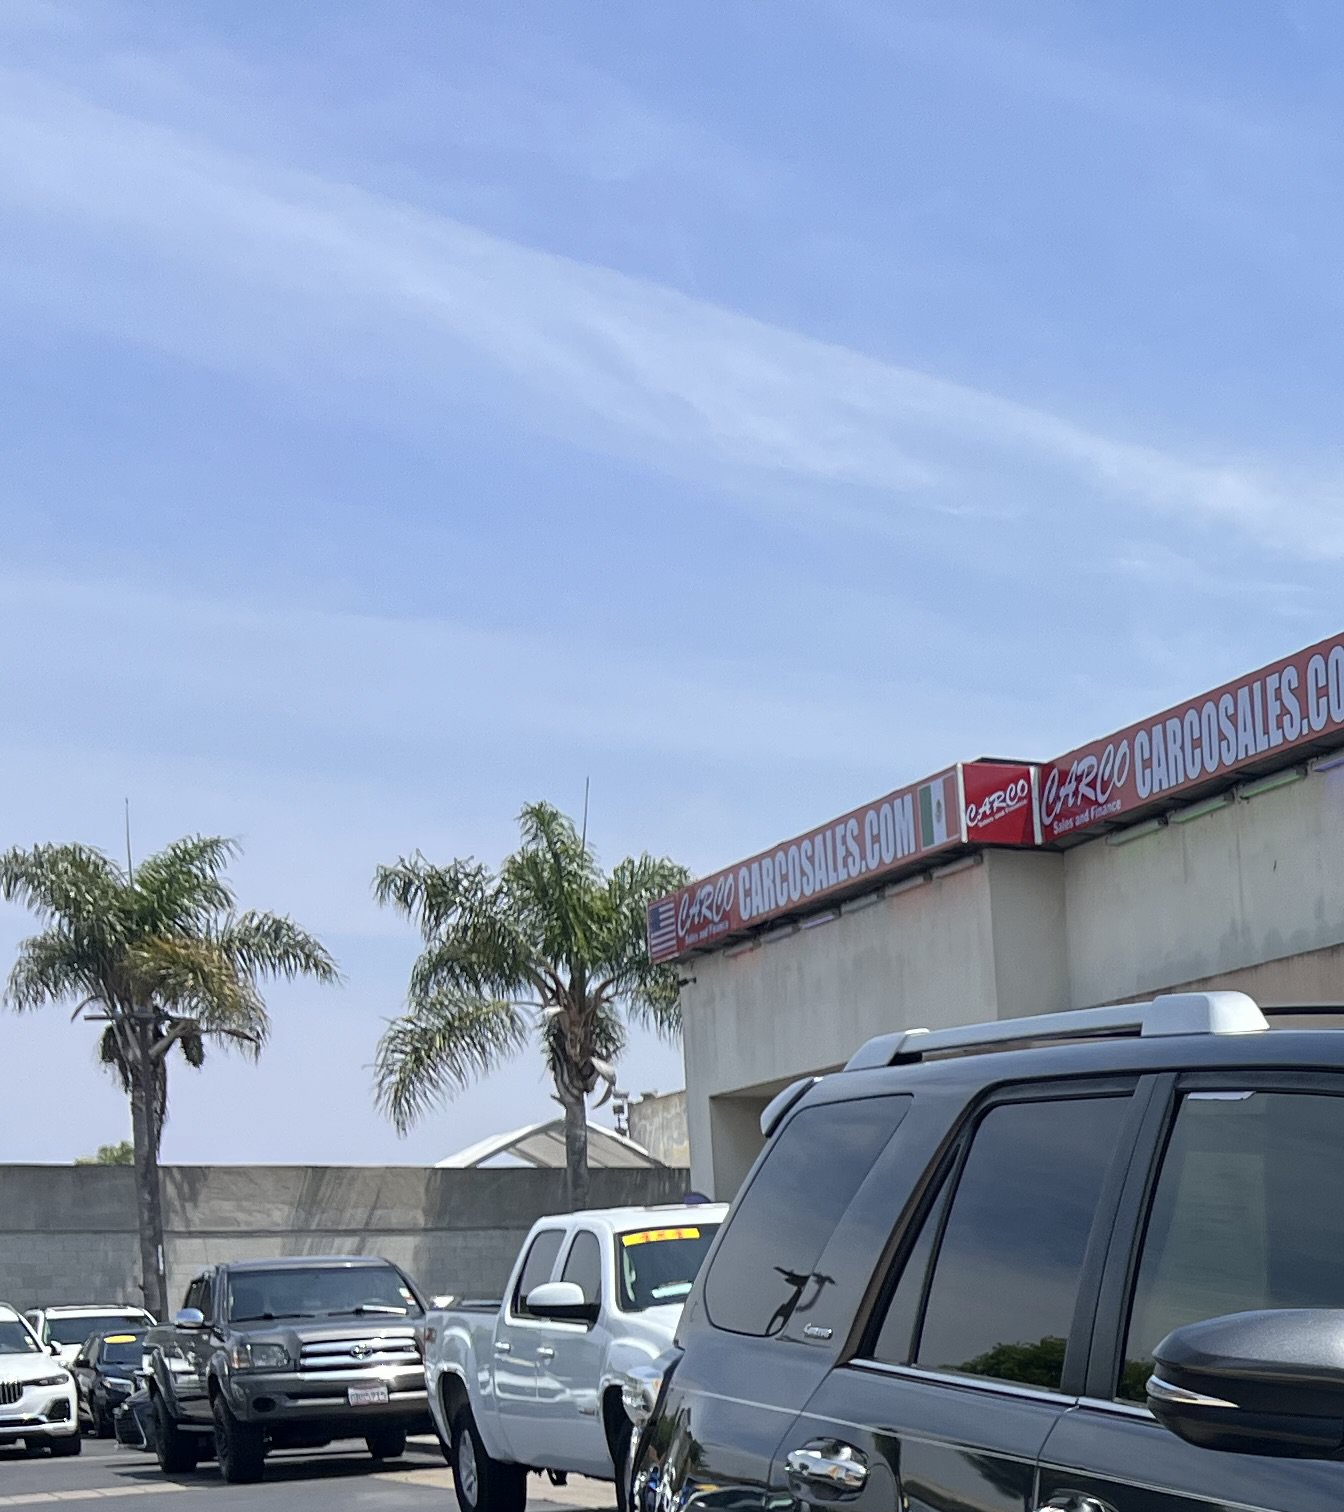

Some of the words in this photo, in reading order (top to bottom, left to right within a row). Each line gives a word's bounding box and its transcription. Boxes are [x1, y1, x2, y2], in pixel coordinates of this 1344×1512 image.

[966, 778, 1028, 827] CARCO
[1041, 739, 1130, 826] CARCO
[1053, 818, 1074, 835] Sales
[1074, 811, 1089, 826] and
[1090, 799, 1121, 821] Finance
[738, 793, 916, 922] CARCOSALES.COM
[677, 873, 735, 938] CARCO
